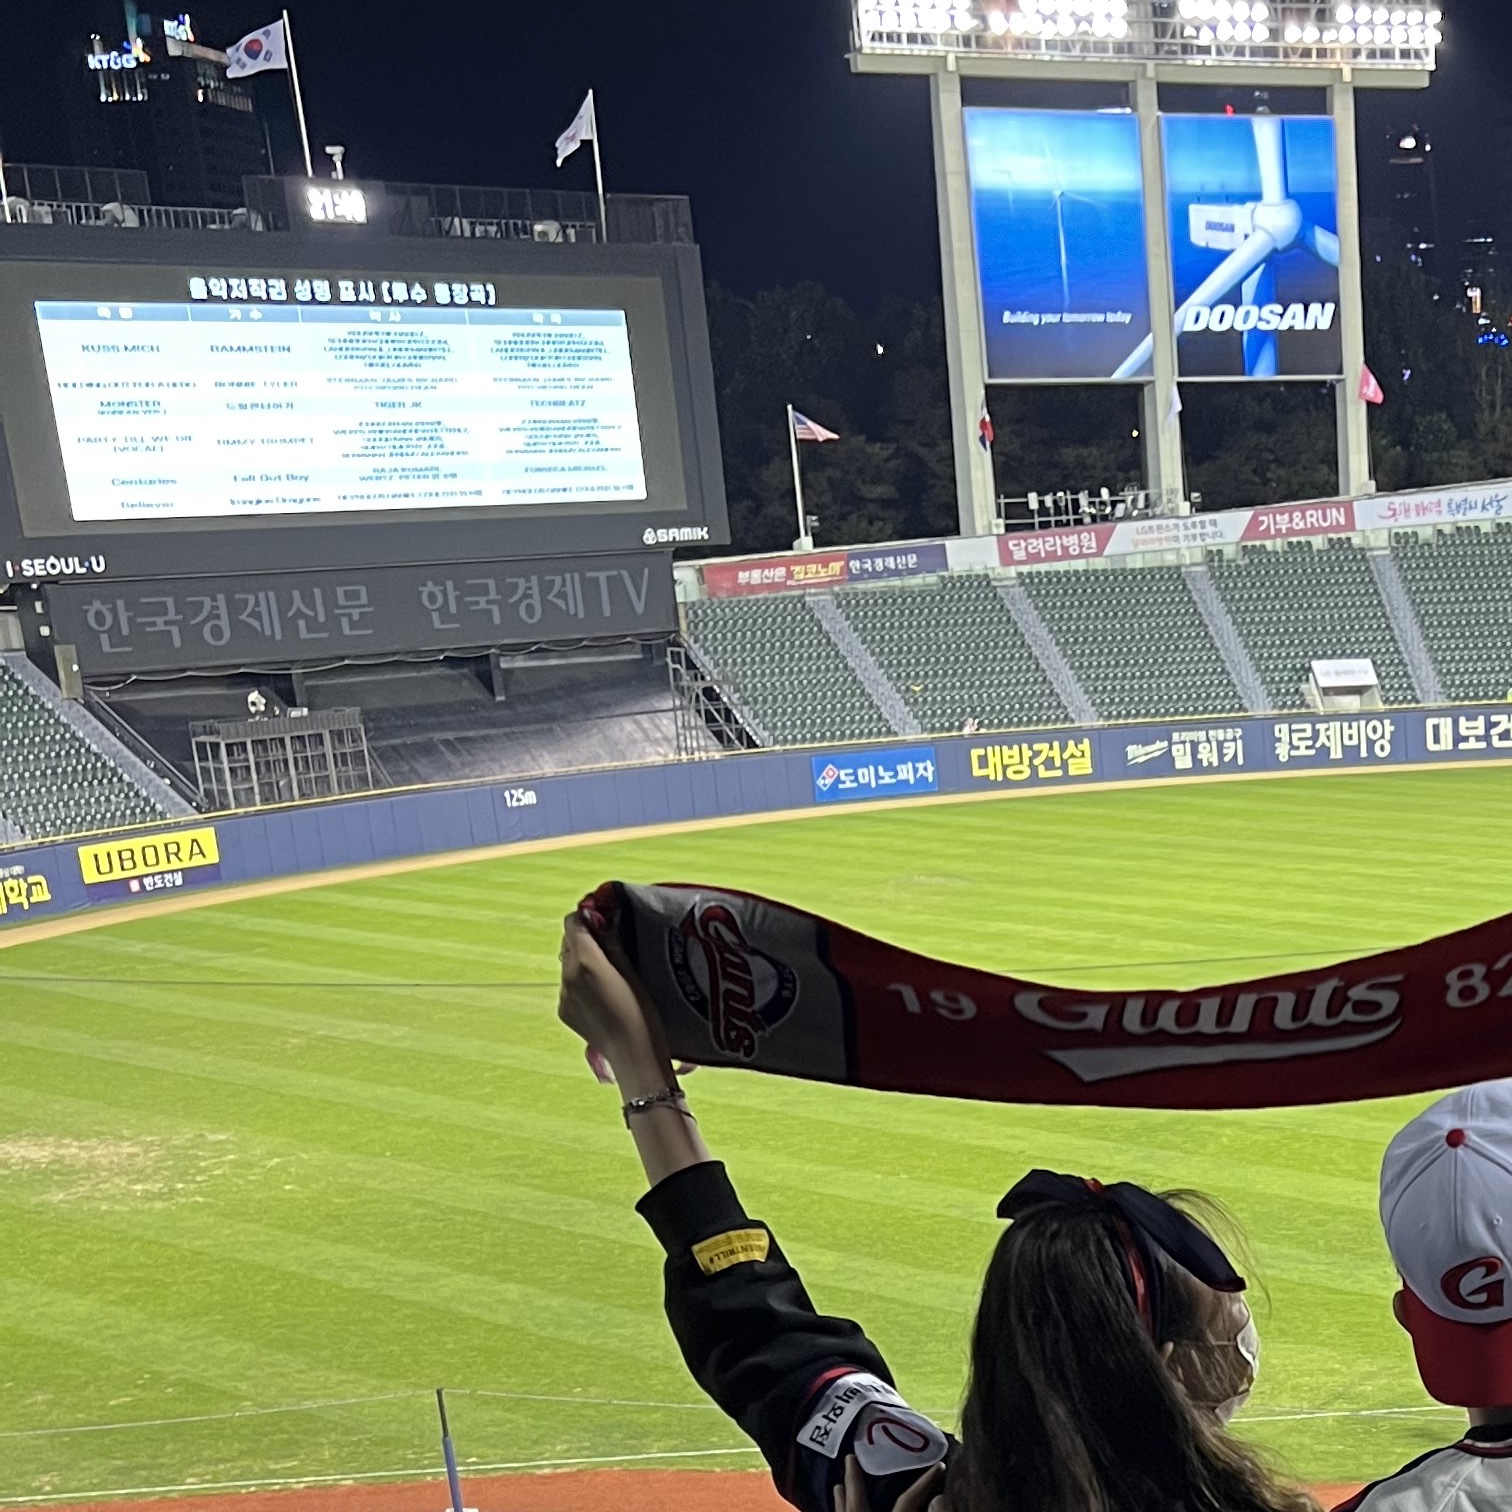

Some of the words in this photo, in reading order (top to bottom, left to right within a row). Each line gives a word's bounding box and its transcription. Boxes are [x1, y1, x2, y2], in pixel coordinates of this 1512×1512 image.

[88, 52, 137, 69] KT&G
[1183, 303, 1335, 331] DOOSAN
[656, 527, 709, 543] SAMIK
[1258, 507, 1345, 536] 기부&RUN
[1008, 531, 1097, 561] 달려라병원
[84, 584, 376, 655] 한국경제신문
[419, 567, 651, 628] 한국경제TV
[1171, 738, 1244, 769] 밀워키
[1290, 719, 1394, 760] 로제비앙
[838, 760, 934, 789] 도미노피자
[970, 738, 1093, 781] 대방건설
[504, 788, 538, 807] 125m
[94, 838, 207, 876] UBORA
[0, 875, 51, 914] 학교
[887, 983, 979, 1021] 19
[1012, 973, 1406, 1036] Giants
[1440, 1256, 1504, 1310] G
